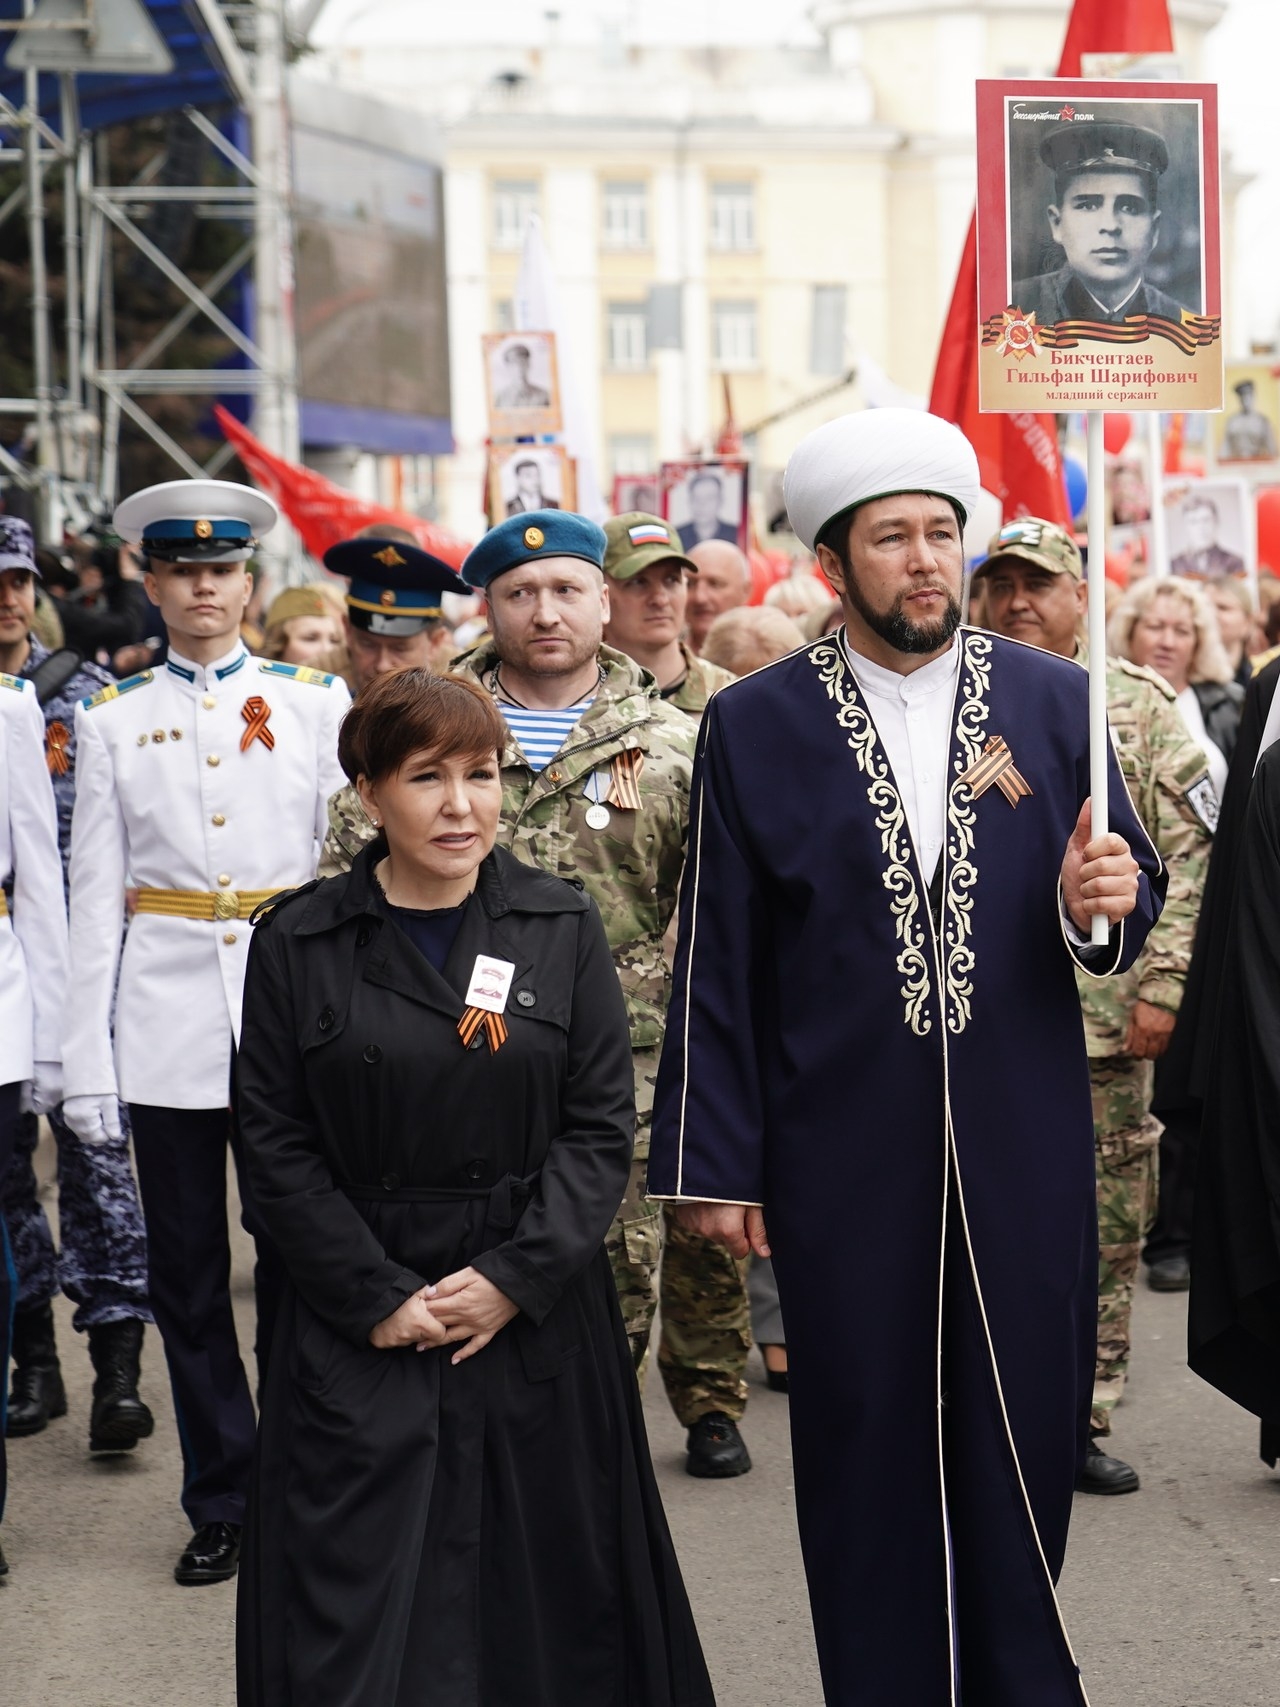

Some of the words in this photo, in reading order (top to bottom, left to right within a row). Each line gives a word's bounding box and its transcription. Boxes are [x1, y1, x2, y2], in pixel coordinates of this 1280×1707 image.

[1050, 350, 1154, 365] Бикчентаев
[1006, 368, 1084, 386] Гильфан
[1090, 368, 1199, 388] Шарифович
[1046, 389, 1104, 401] младший
[1107, 391, 1159, 402] сержант
